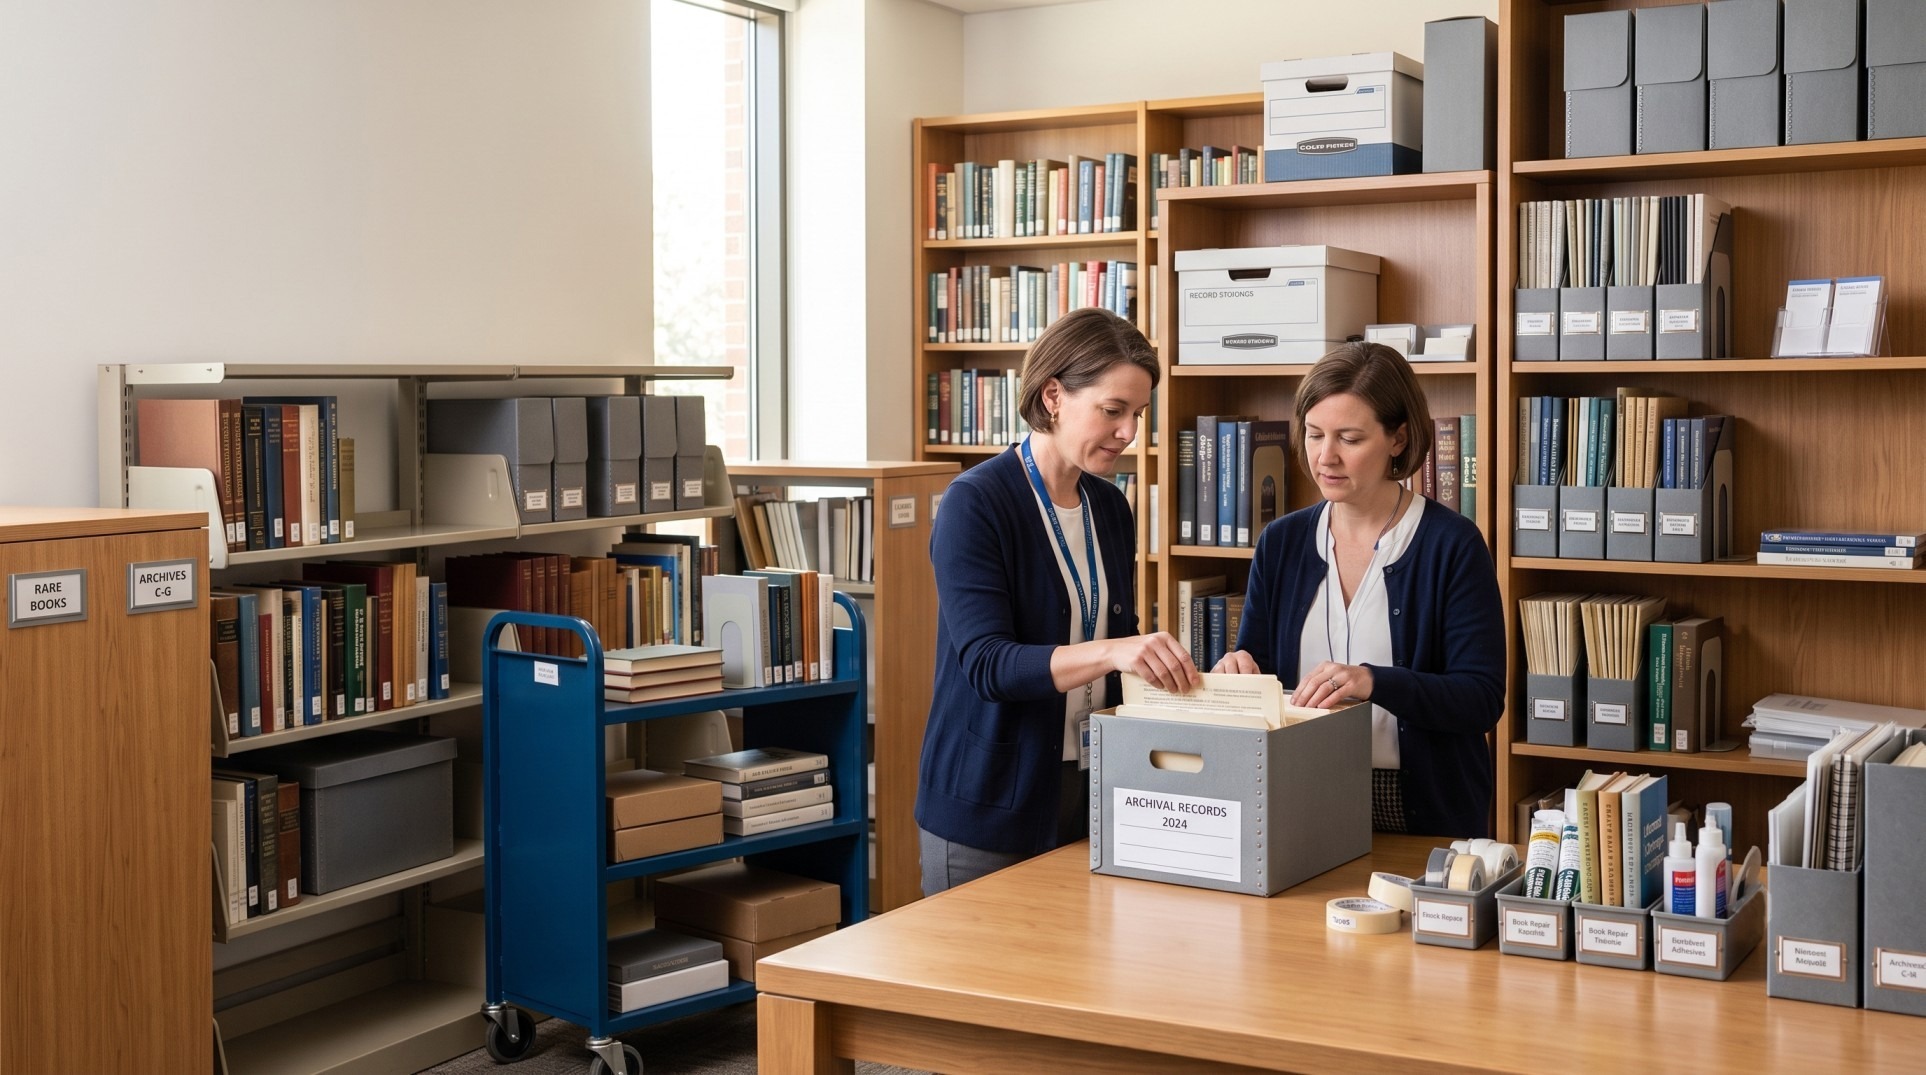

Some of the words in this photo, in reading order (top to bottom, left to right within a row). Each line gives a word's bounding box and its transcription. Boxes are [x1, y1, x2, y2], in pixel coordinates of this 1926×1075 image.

[1189, 291, 1218, 299] RECORD
[139, 570, 187, 585] ARCHIVES
[34, 582, 62, 595] RARE
[155, 586, 172, 598] C-G
[30, 597, 67, 611] BOOKS
[1125, 796, 1176, 812] ARCHIVAL
[1178, 802, 1227, 818] RECORDS
[1162, 817, 1188, 829] 2024
[1512, 918, 1528, 926] Book
[1530, 920, 1550, 929] Repair
[1588, 927, 1606, 936] Book
[1607, 930, 1629, 940] Repair
[1671, 946, 1706, 957] Adhesives
